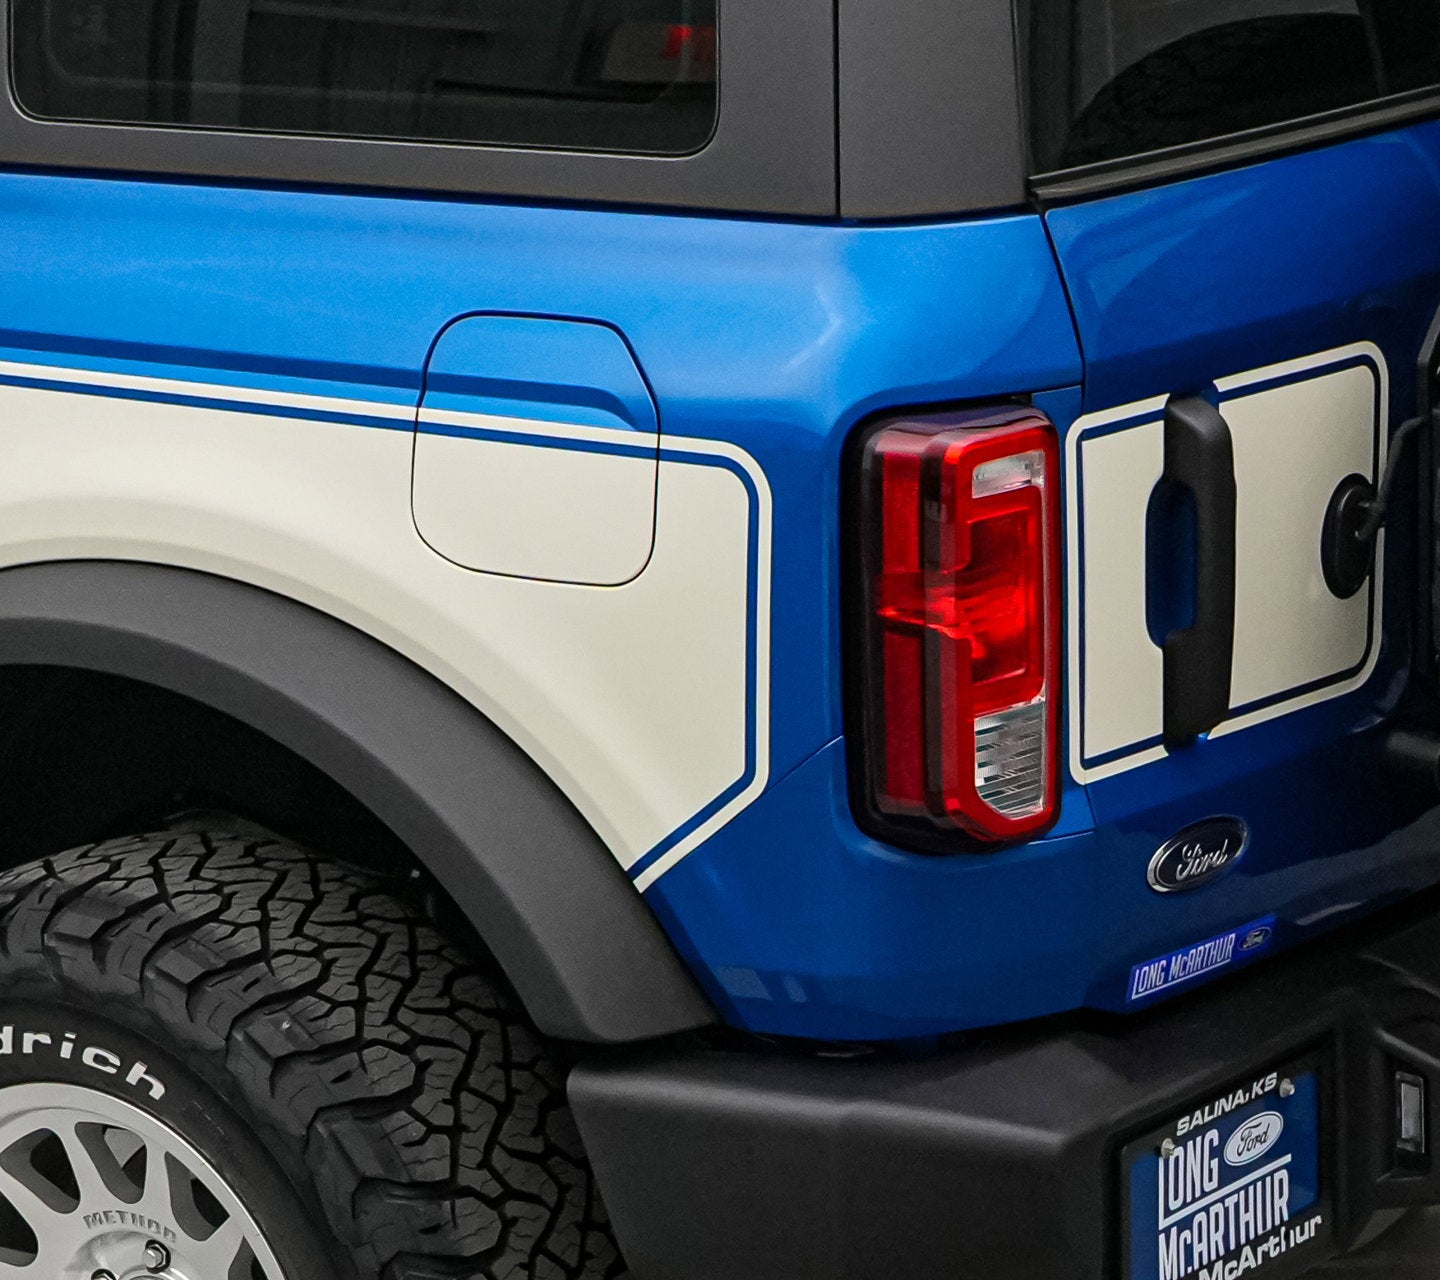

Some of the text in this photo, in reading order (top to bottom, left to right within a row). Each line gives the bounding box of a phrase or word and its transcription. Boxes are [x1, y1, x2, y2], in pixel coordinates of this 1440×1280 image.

[1175, 838, 1229, 881] Ford
[1131, 933, 1236, 1000] LONG McARTHUR
[1251, 1071, 1278, 1100] KS
[1158, 1128, 1220, 1230] LONG
[82, 1209, 177, 1243] METHOD
